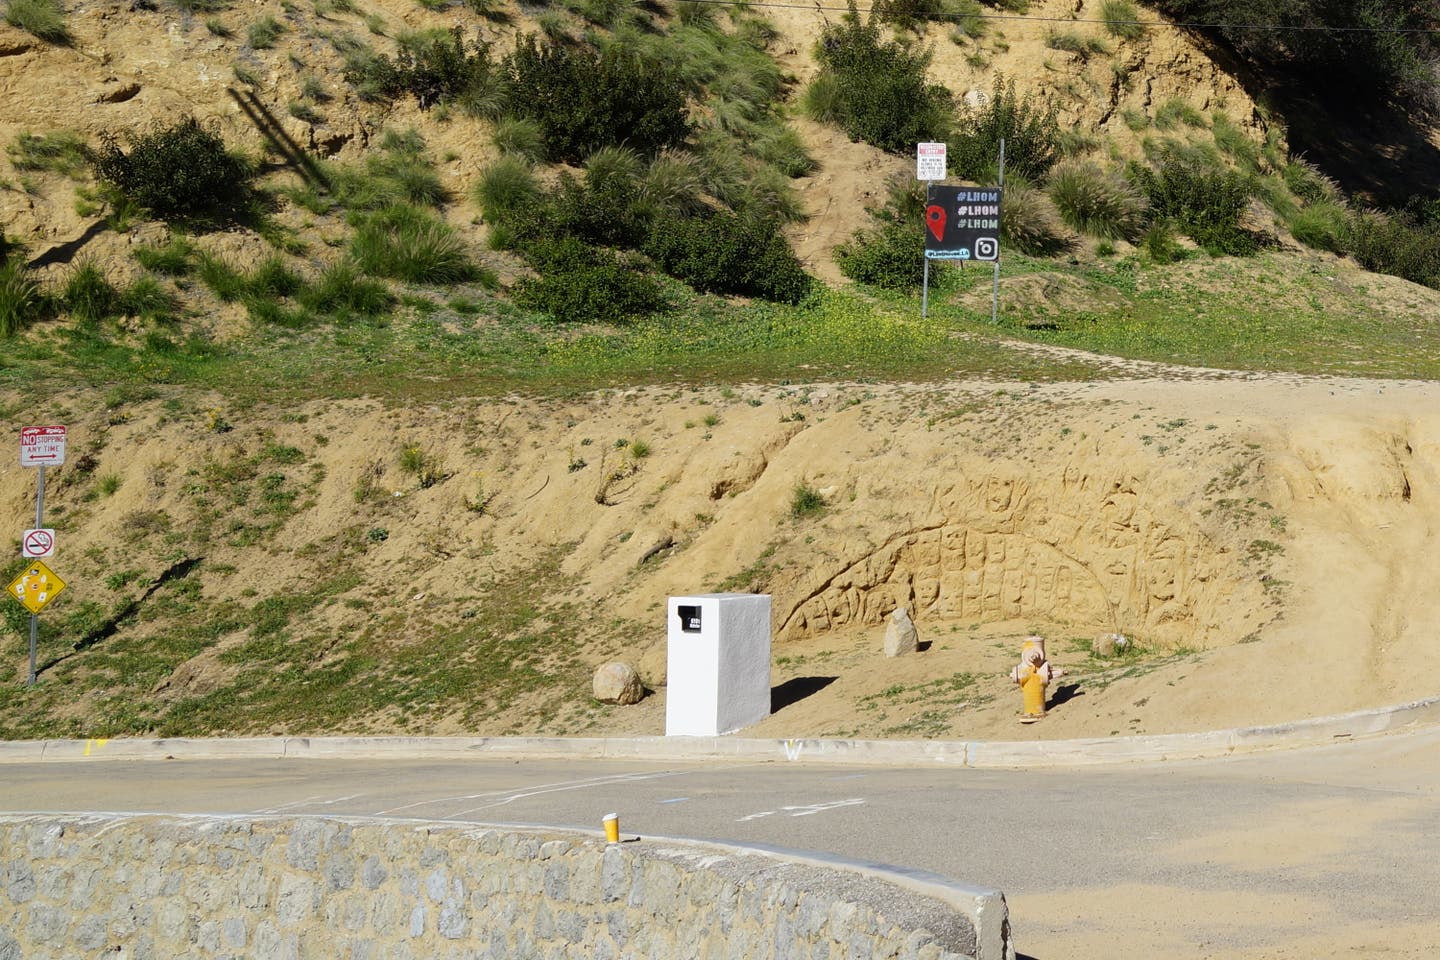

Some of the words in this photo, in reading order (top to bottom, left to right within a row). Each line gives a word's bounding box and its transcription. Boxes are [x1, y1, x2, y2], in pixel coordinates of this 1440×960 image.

[956, 191, 998, 202] #LHOM
[957, 205, 999, 216] #LHOM
[957, 218, 998, 229] #LHOM
[23, 434, 36, 445] NO
[36, 435, 63, 444] STOPPING
